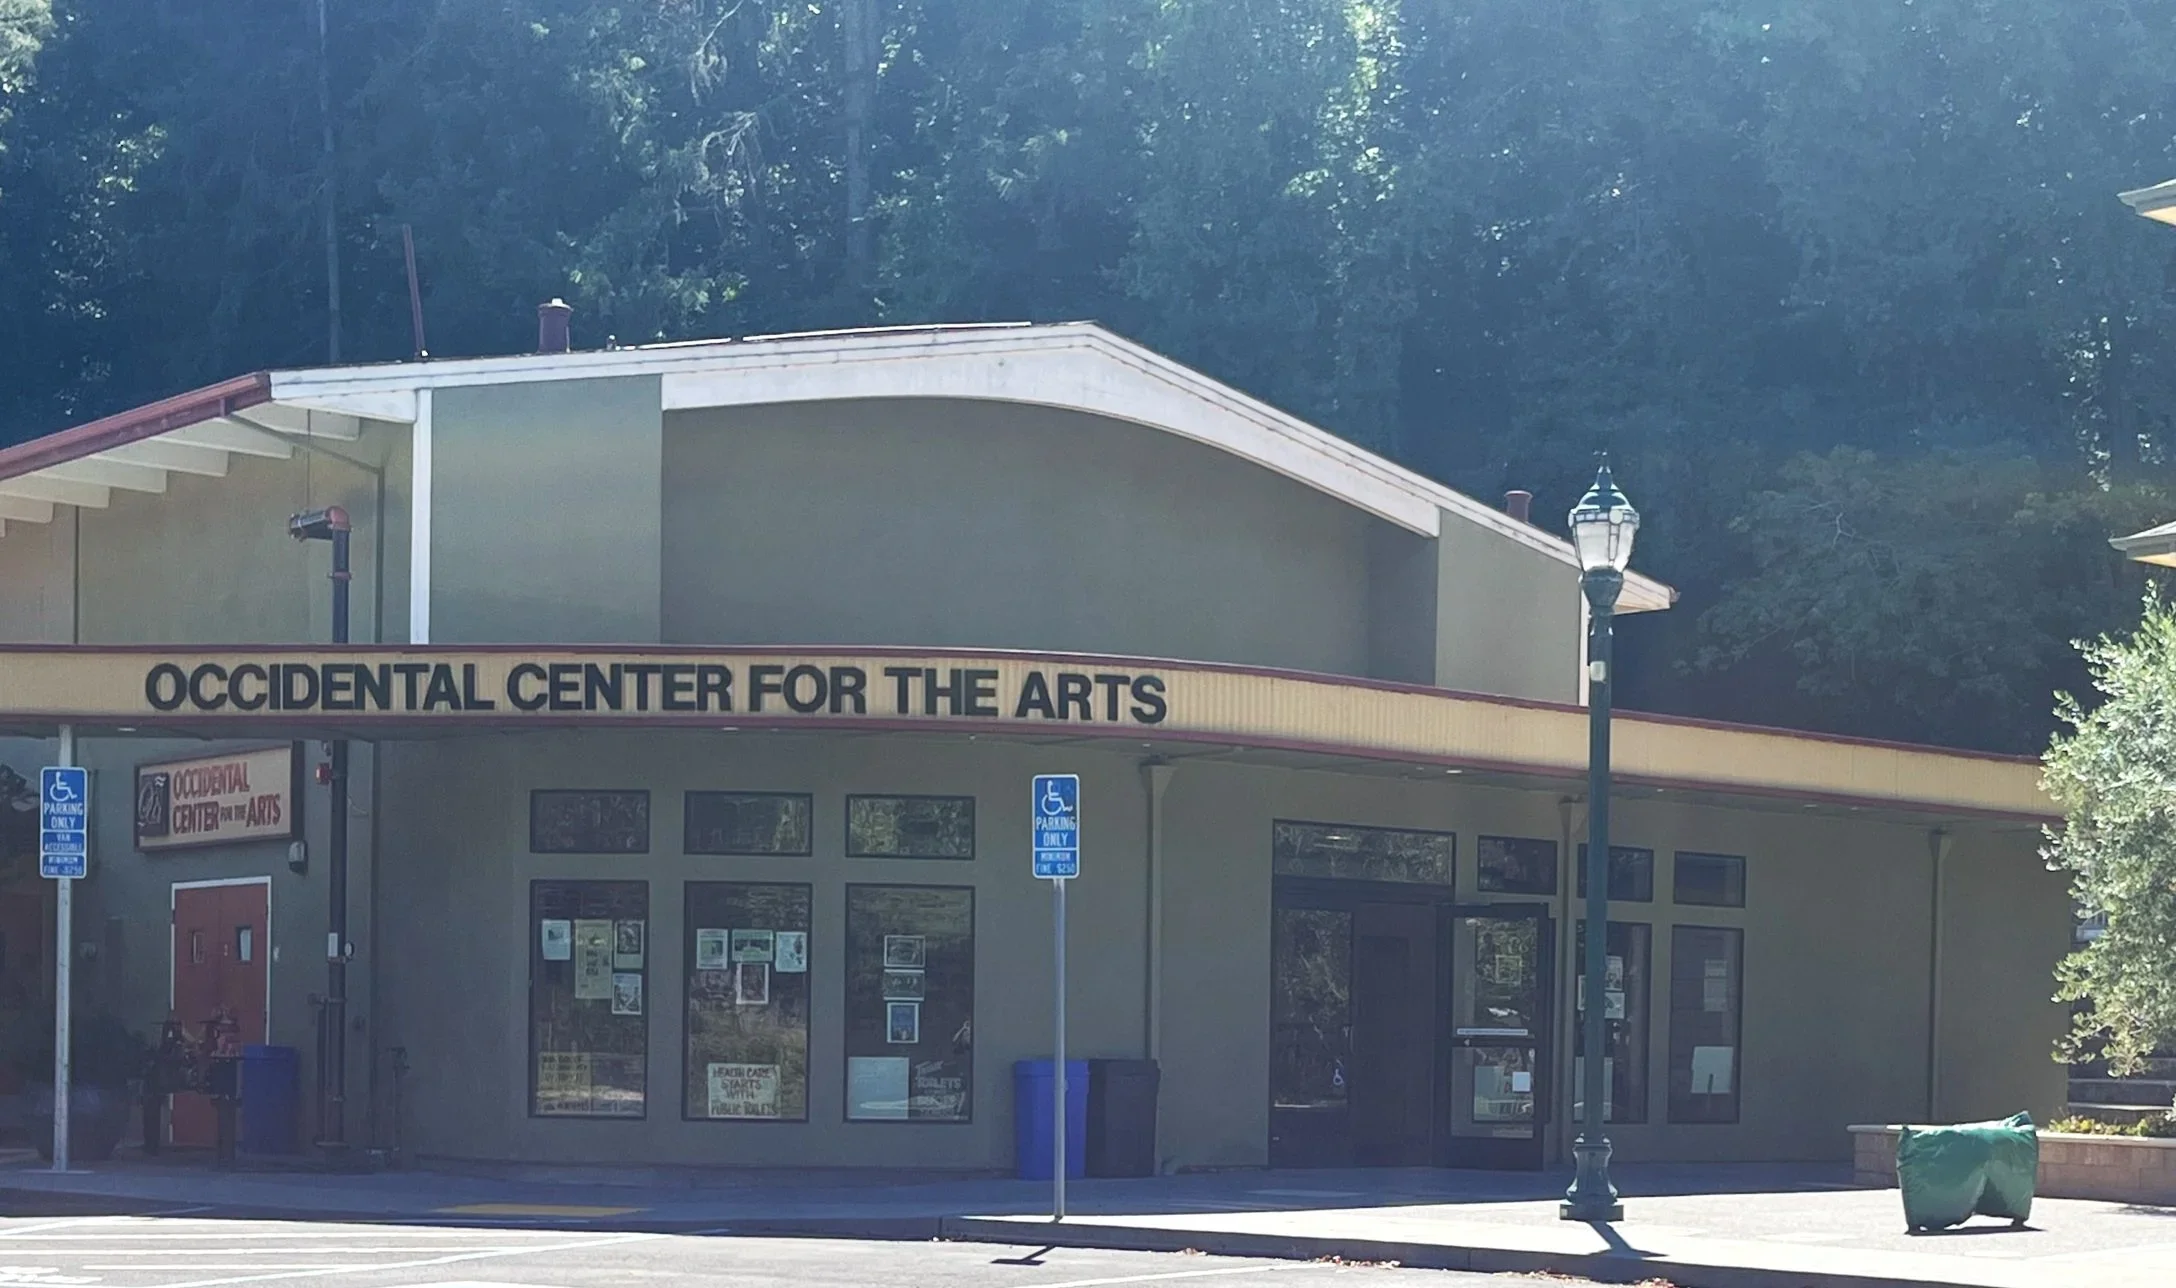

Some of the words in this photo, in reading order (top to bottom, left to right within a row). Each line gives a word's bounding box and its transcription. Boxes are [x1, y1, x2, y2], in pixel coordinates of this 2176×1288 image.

[145, 663, 495, 711] OCCIDENTAL
[506, 663, 732, 712] CENTER
[749, 664, 868, 713] FOR
[885, 667, 999, 717] THE
[1015, 671, 1168, 724] ARTS
[173, 762, 250, 800] OCCIDENTAL
[44, 802, 83, 815] PARKING
[173, 801, 219, 834] CENTER
[220, 805, 233, 821] FOR
[246, 793, 281, 827] ARTS
[51, 816, 76, 829] ONLY
[1036, 816, 1076, 830] PARKING
[1043, 832, 1068, 846] ONLY
[713, 1067, 745, 1078] HEALTH
[721, 1079, 761, 1090] STARTS
[726, 1090, 755, 1100] WITH
[712, 1102, 741, 1115] PUBLIC
[743, 1101, 777, 1116] TOILETS
